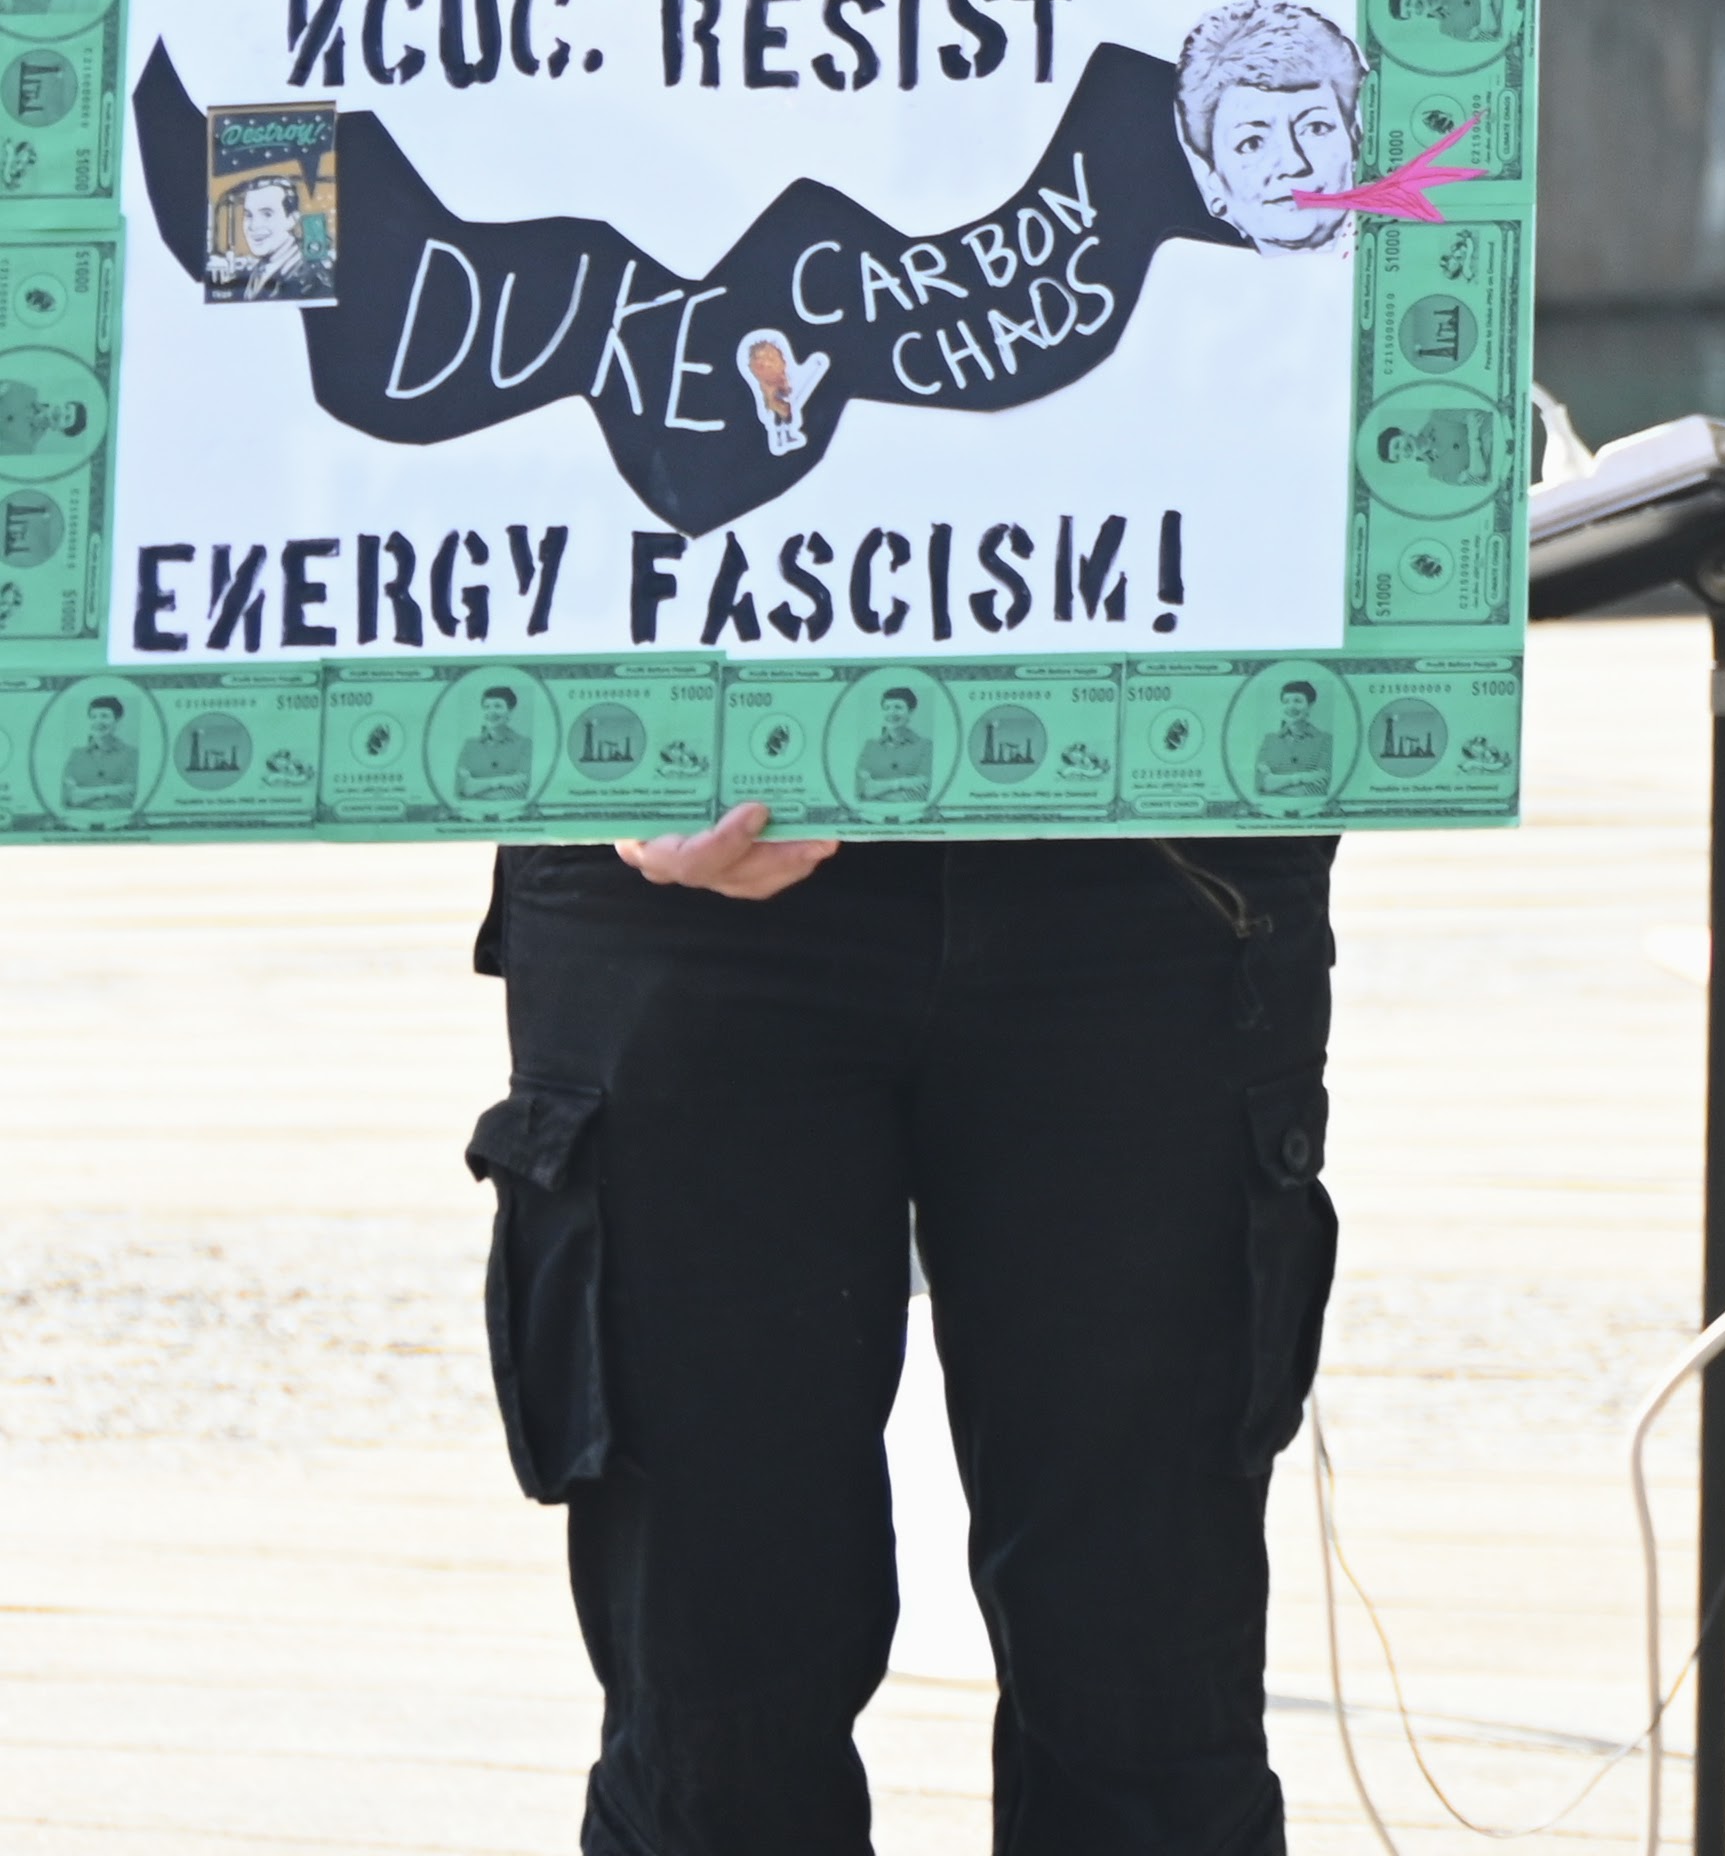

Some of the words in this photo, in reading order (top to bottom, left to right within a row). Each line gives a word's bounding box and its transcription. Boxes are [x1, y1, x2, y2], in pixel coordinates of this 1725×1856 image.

[221, 121, 326, 146] Destroy!
[792, 151, 1098, 325] CARBON
[892, 236, 1116, 394] CHAOS
[386, 238, 728, 433] DUKE
[133, 524, 569, 652] ENERGY
[630, 509, 1185, 644] FASCISM!
